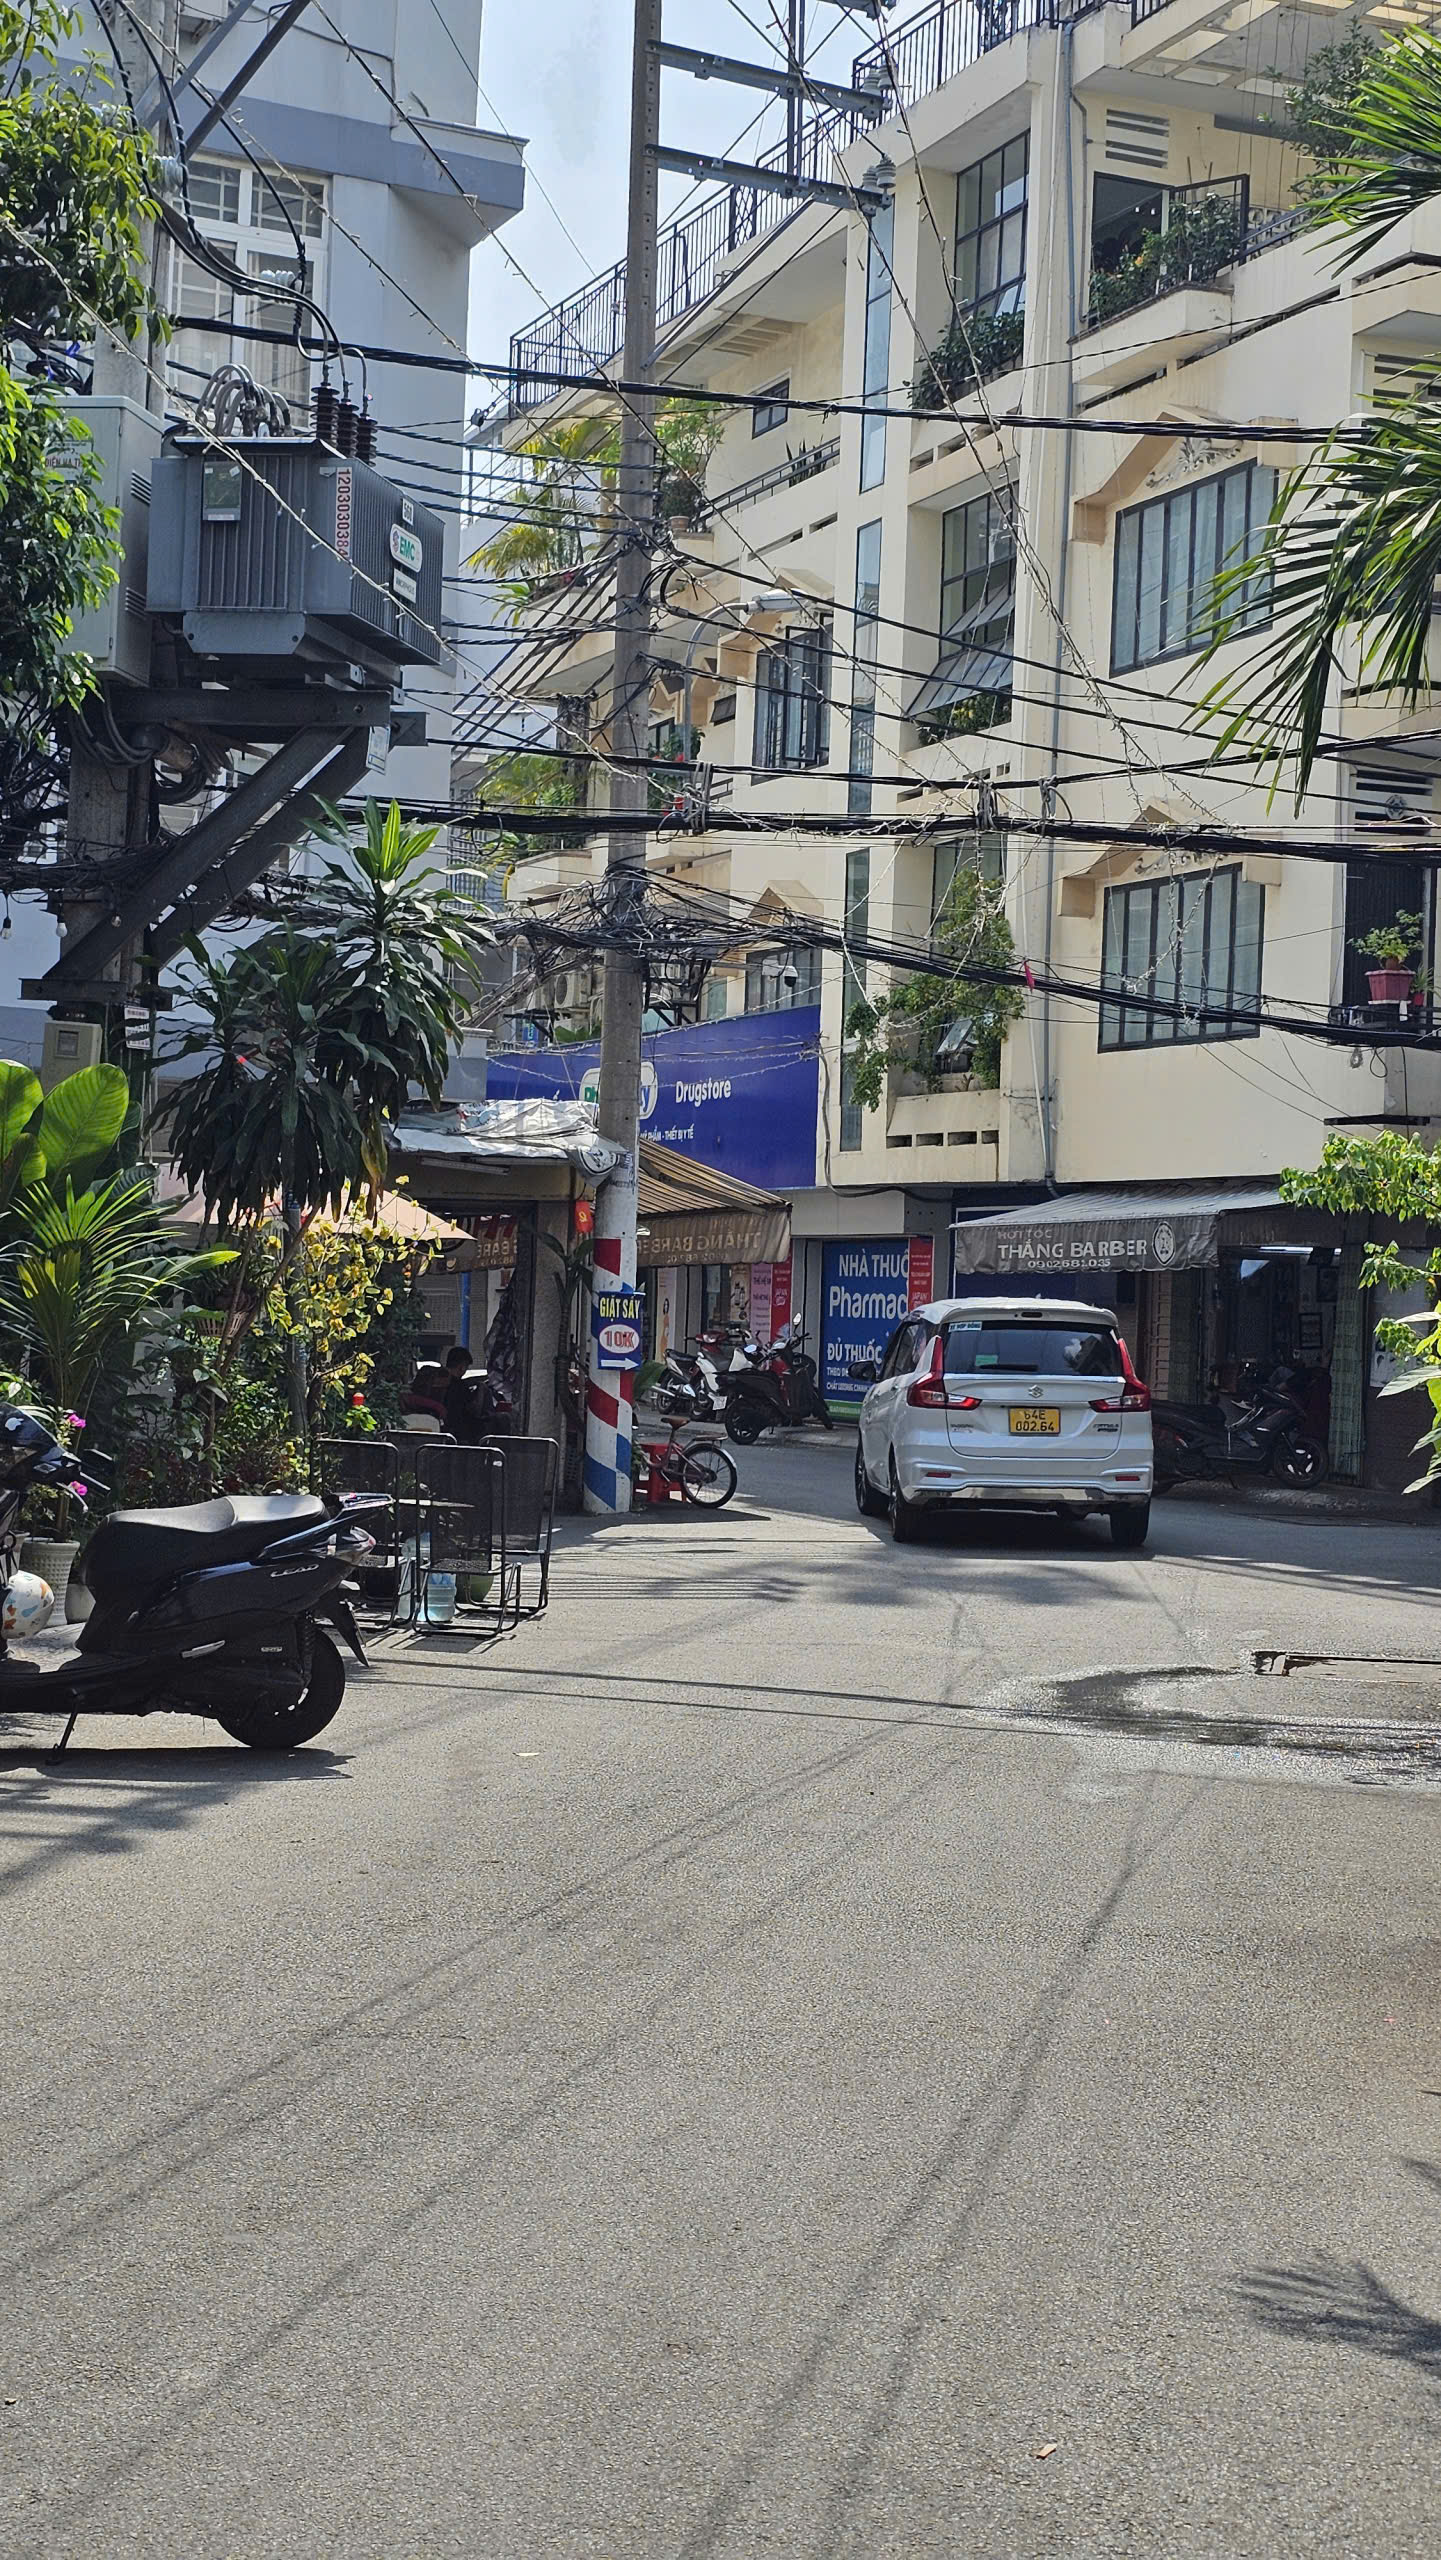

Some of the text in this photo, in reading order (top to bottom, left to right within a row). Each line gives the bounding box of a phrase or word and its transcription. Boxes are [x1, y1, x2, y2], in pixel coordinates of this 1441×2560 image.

[400, 536, 415, 561] EMC
[676, 1079, 732, 1107] Drugstore
[998, 1239, 1064, 1259] THẮNG
[1070, 1239, 1147, 1258] BARBER
[839, 1249, 869, 1278] NHÀ
[600, 1295, 621, 1322] GIẶT
[829, 1285, 909, 1320] Pharmac
[604, 1331, 634, 1348] 10K
[827, 1337, 882, 1364] ĐỦ THUỐC
[1016, 1421, 1054, 1431] 002.64
